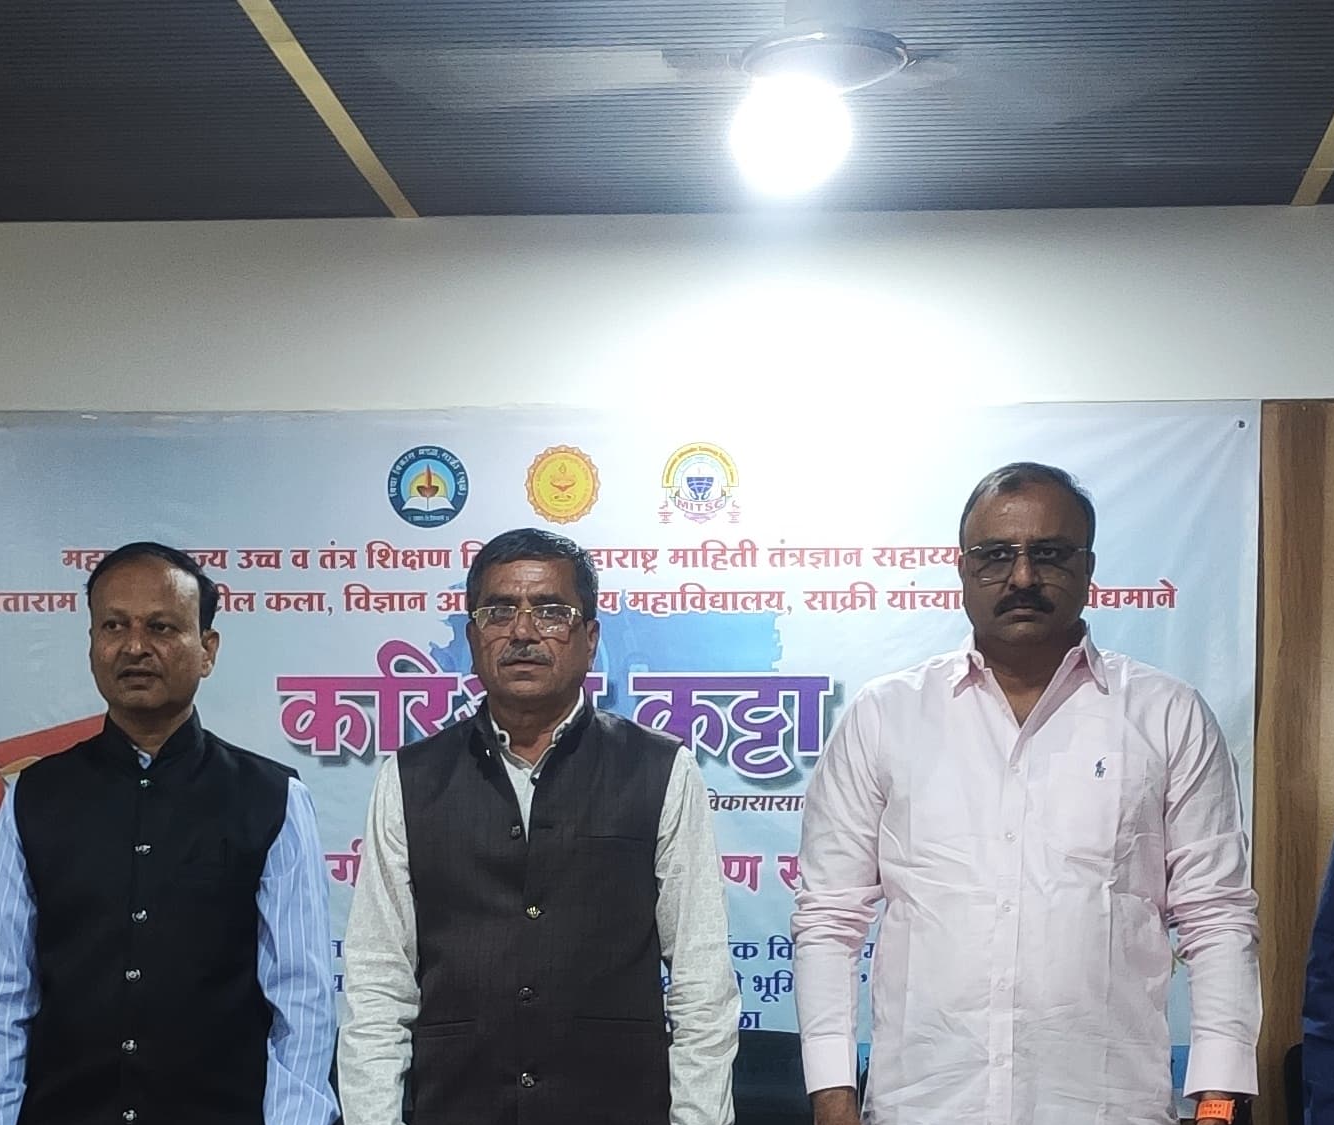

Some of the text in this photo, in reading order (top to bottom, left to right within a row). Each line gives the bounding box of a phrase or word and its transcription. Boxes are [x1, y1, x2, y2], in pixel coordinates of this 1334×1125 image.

[237, 549, 282, 569] उच्च
[291, 549, 310, 569] व
[318, 540, 357, 569] तंत्र
[366, 540, 452, 570] शिक्षण
[668, 539, 759, 570] माहिती
[767, 538, 863, 569] तंत्रज्ञान
[265, 592, 333, 615] कला,
[343, 583, 427, 613] विज्ञान
[628, 583, 793, 615] महाविद्यालय,
[803, 581, 878, 613] साक्री
[631, 675, 830, 776] कट्टा
